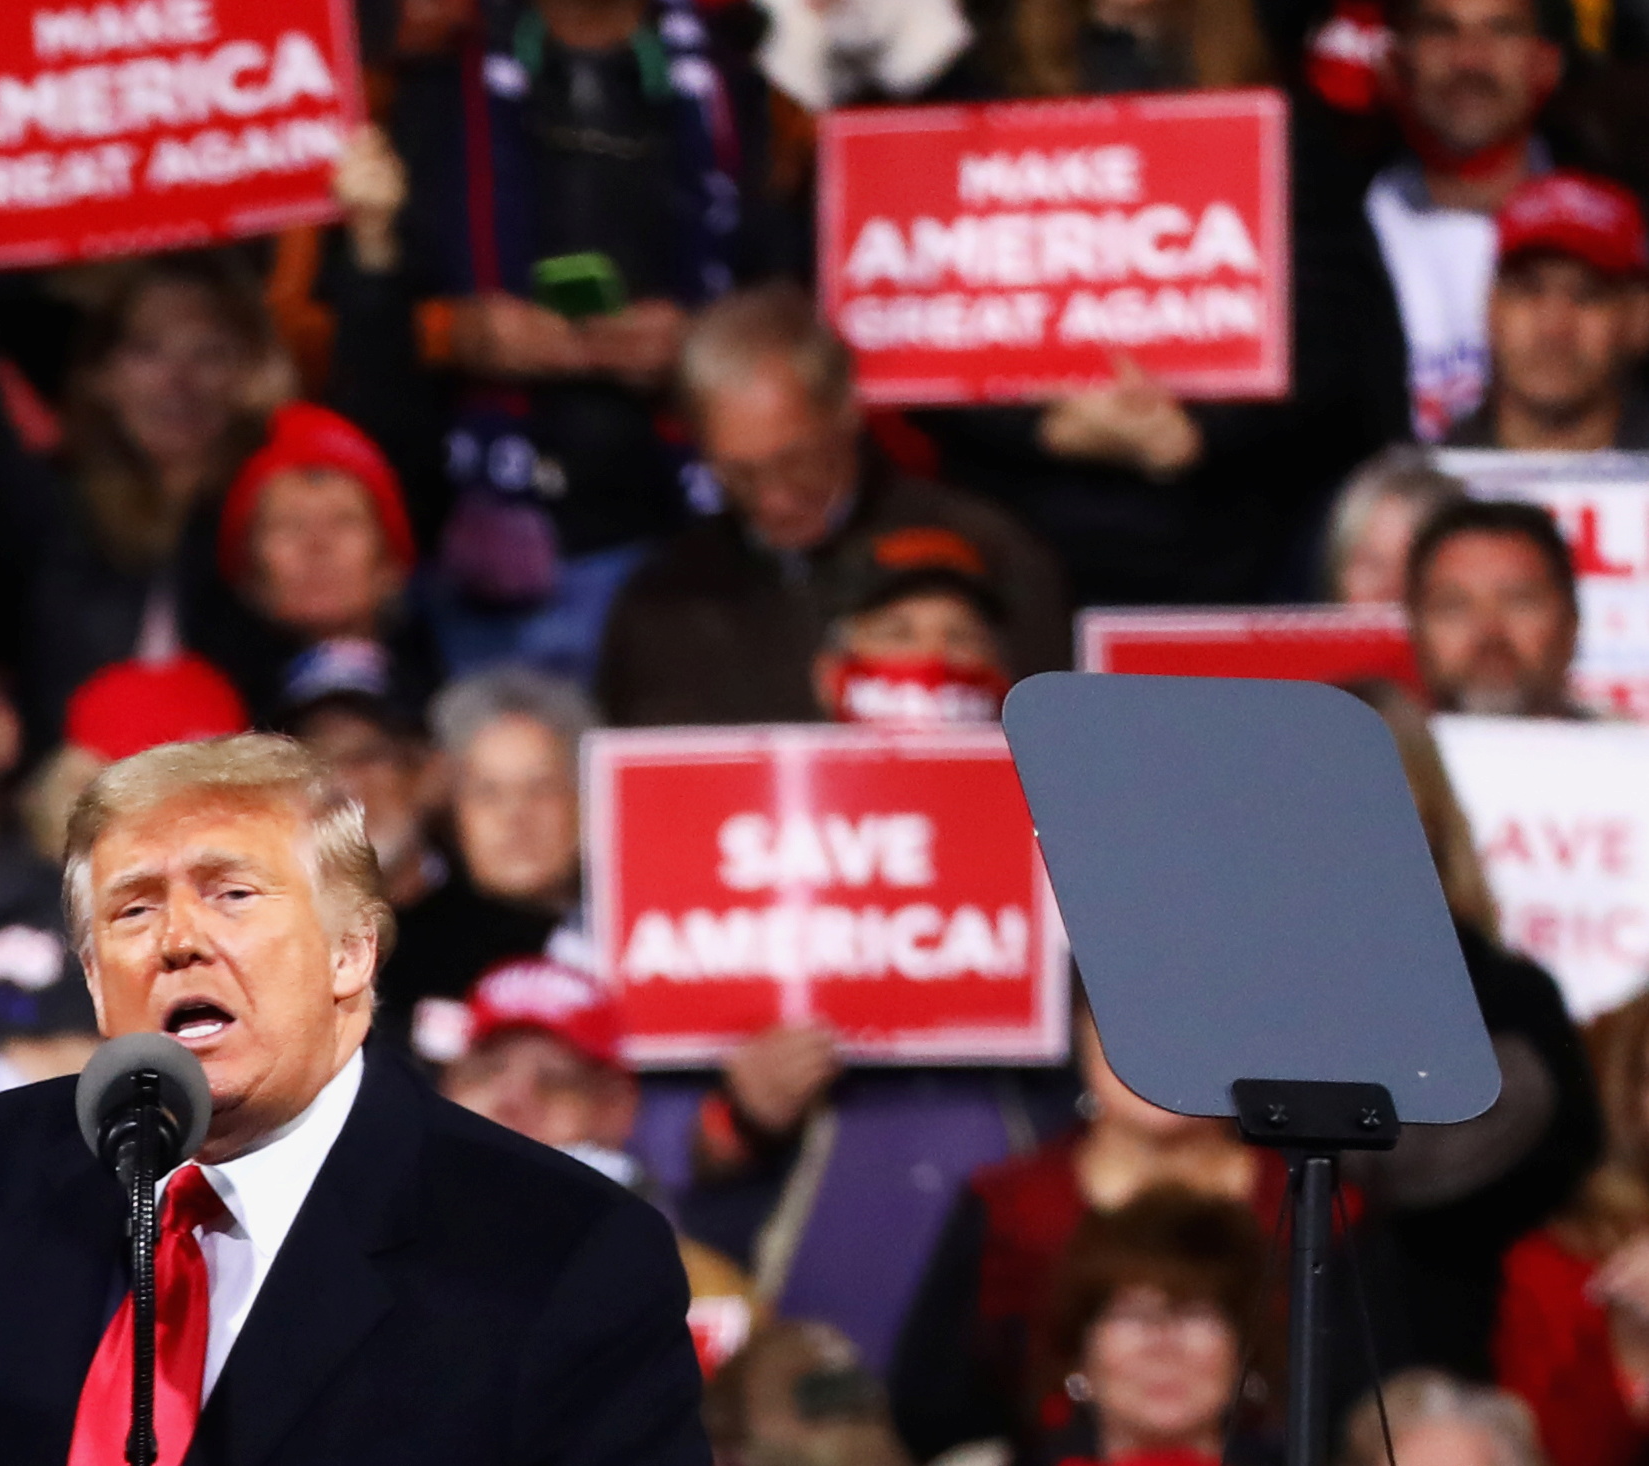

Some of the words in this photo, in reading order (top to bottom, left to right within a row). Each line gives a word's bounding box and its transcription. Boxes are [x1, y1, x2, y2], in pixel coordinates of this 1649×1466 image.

[32, 0, 215, 60] MAKE
[146, 116, 342, 190] AGAIN
[958, 145, 1141, 204] MAKE
[843, 203, 1256, 288] AMERICA
[841, 290, 1048, 350] GREAT
[1058, 285, 1258, 345] AGAIN
[717, 813, 938, 890] SAVE
[624, 907, 1029, 983] AMERICA!
